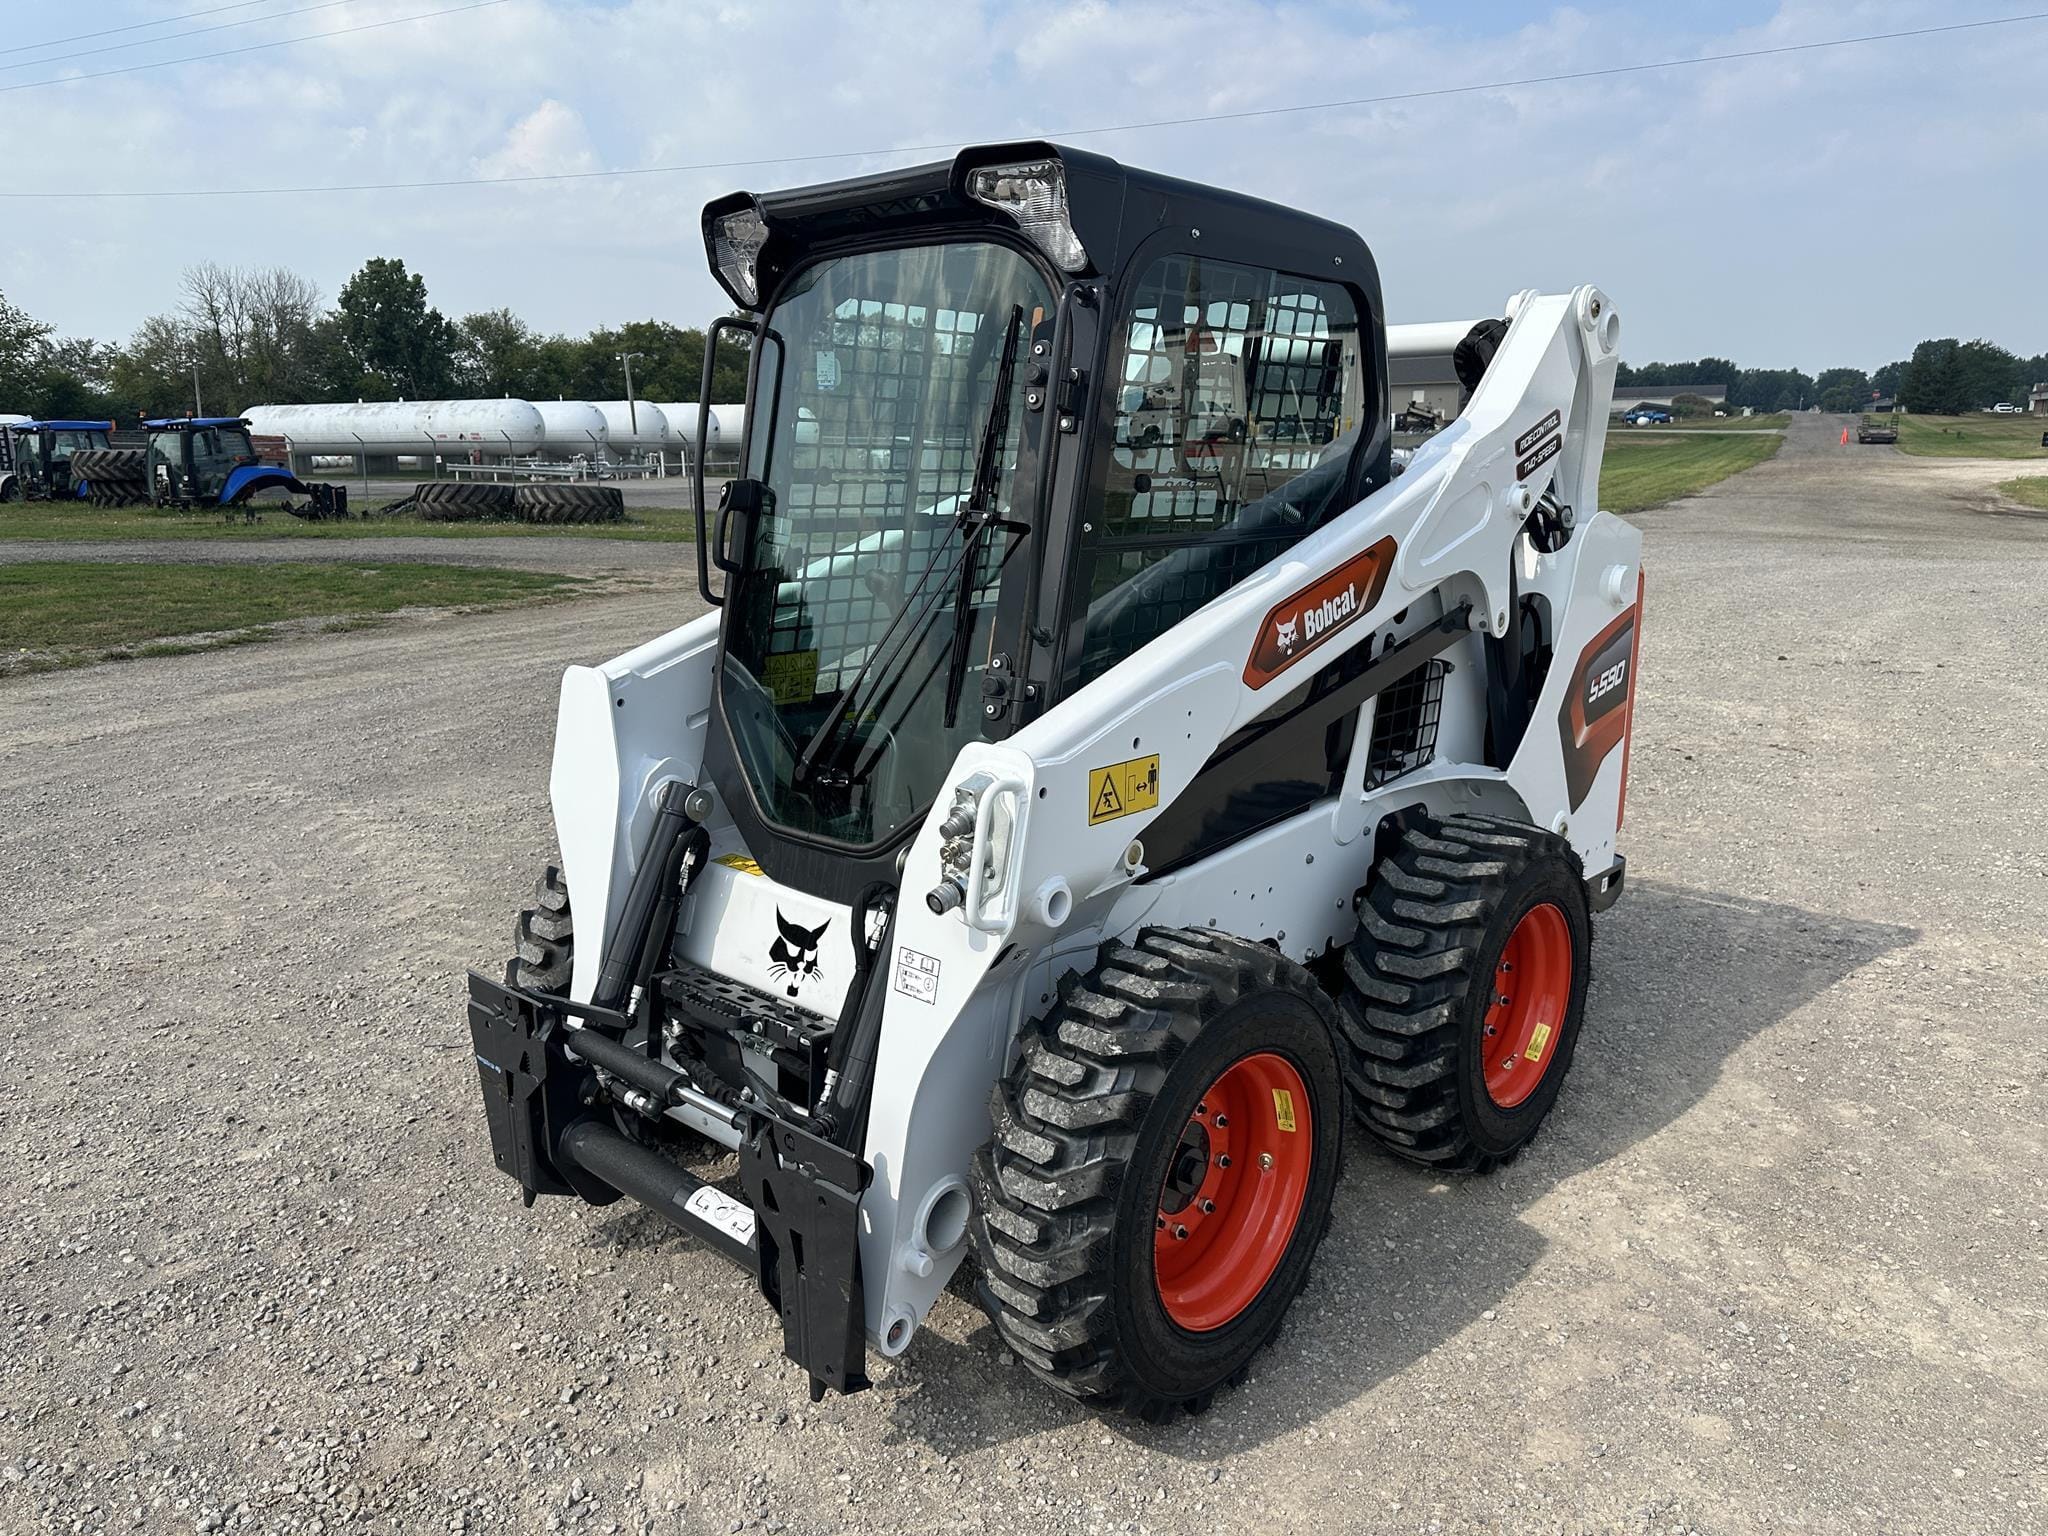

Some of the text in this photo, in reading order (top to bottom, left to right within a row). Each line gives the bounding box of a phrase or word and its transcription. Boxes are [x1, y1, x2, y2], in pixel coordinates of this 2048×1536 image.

[1520, 415, 1559, 452] RIDE CONTROL
[1524, 439, 1557, 473] TWO-SPEED
[1304, 582, 1356, 641] Bobcat
[1588, 659, 1626, 704] S590
